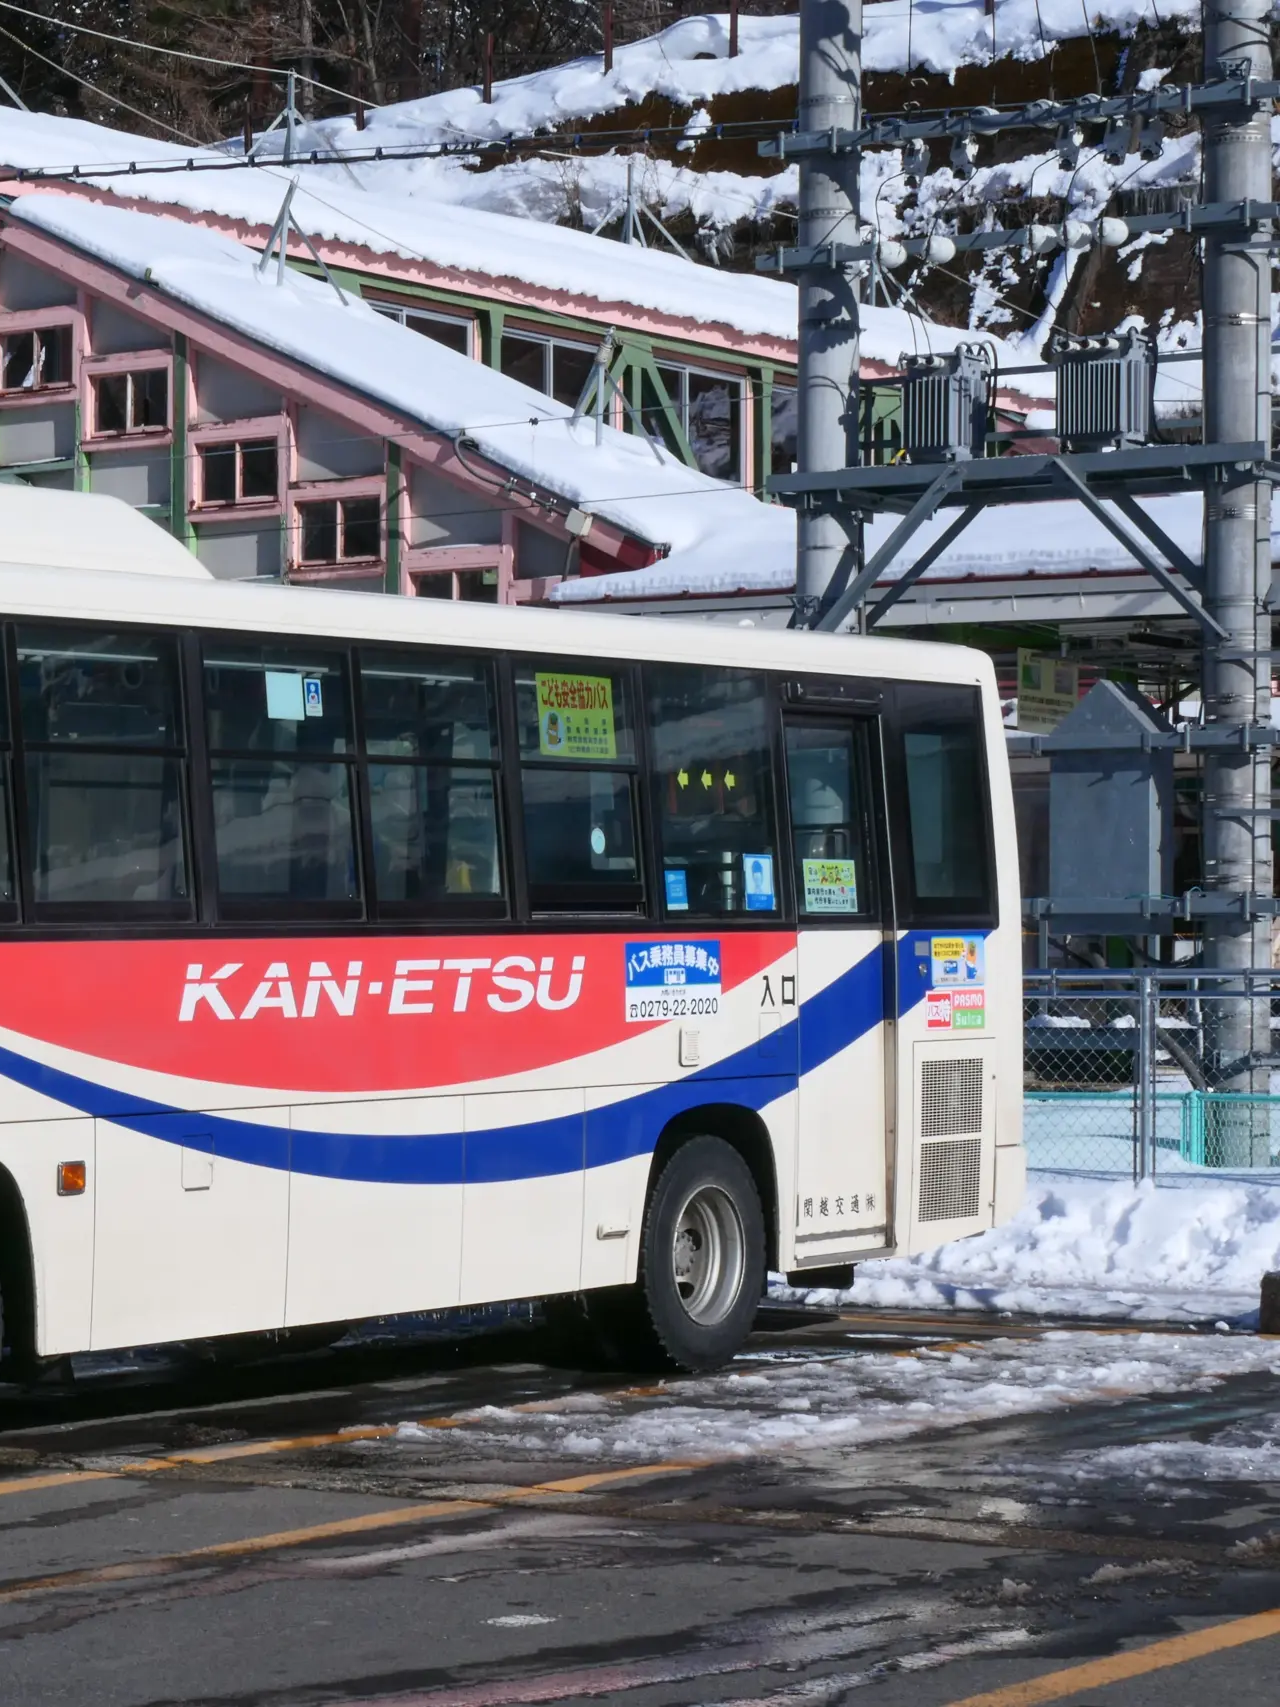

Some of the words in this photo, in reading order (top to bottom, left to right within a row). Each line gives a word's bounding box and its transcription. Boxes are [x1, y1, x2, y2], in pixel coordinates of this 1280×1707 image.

[627, 944, 720, 982] バス乗務員募集中
[760, 974, 796, 1007] 入口
[954, 992, 983, 1007] PASMO
[955, 1012, 983, 1026] Suica
